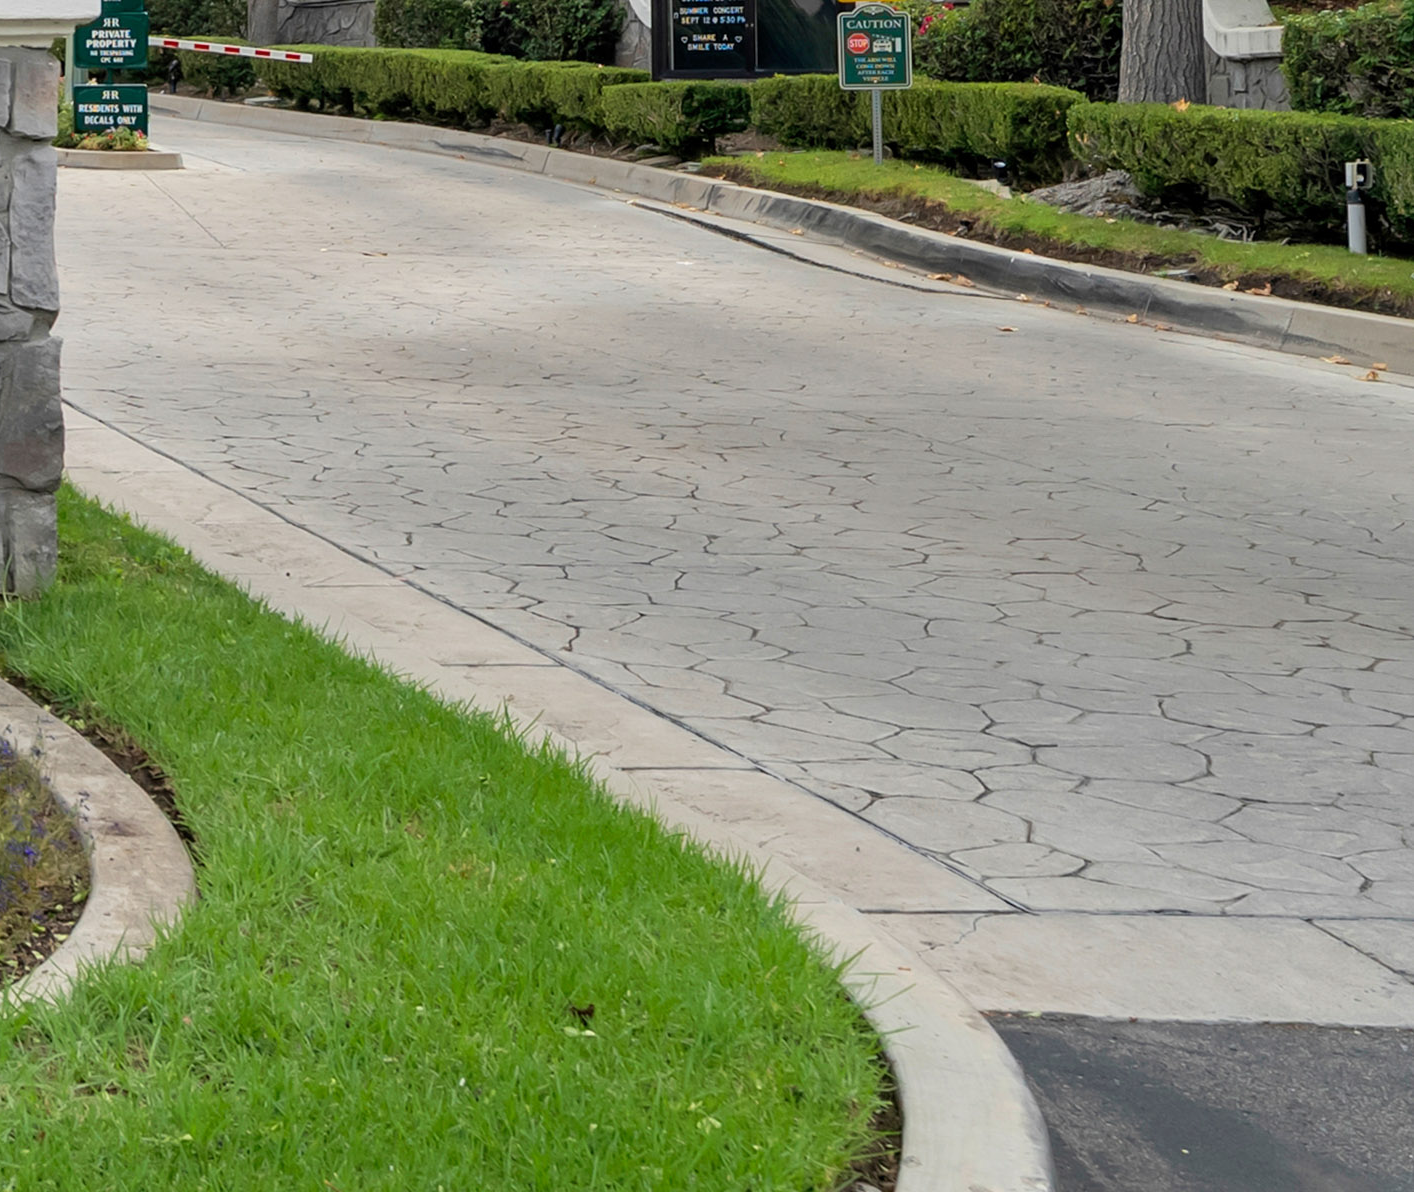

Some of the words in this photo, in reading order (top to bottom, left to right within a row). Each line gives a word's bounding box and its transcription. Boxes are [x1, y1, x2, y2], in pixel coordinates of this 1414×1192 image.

[679, 7, 709, 15] SUMMER
[713, 6, 744, 14] CONCERT
[681, 16, 699, 25] SEPT
[846, 19, 902, 29] CAUTION
[91, 29, 131, 38] PRIVATE
[692, 34, 716, 42] SHARE
[86, 39, 137, 48] PROPERTY
[687, 43, 710, 51] SMILE
[713, 43, 735, 51] TODAY
[849, 38, 868, 48] STOP
[78, 104, 120, 113] RESIDENTS
[122, 104, 143, 113] WITH
[84, 115, 114, 125] DECALS
[116, 115, 137, 125] ONLY
